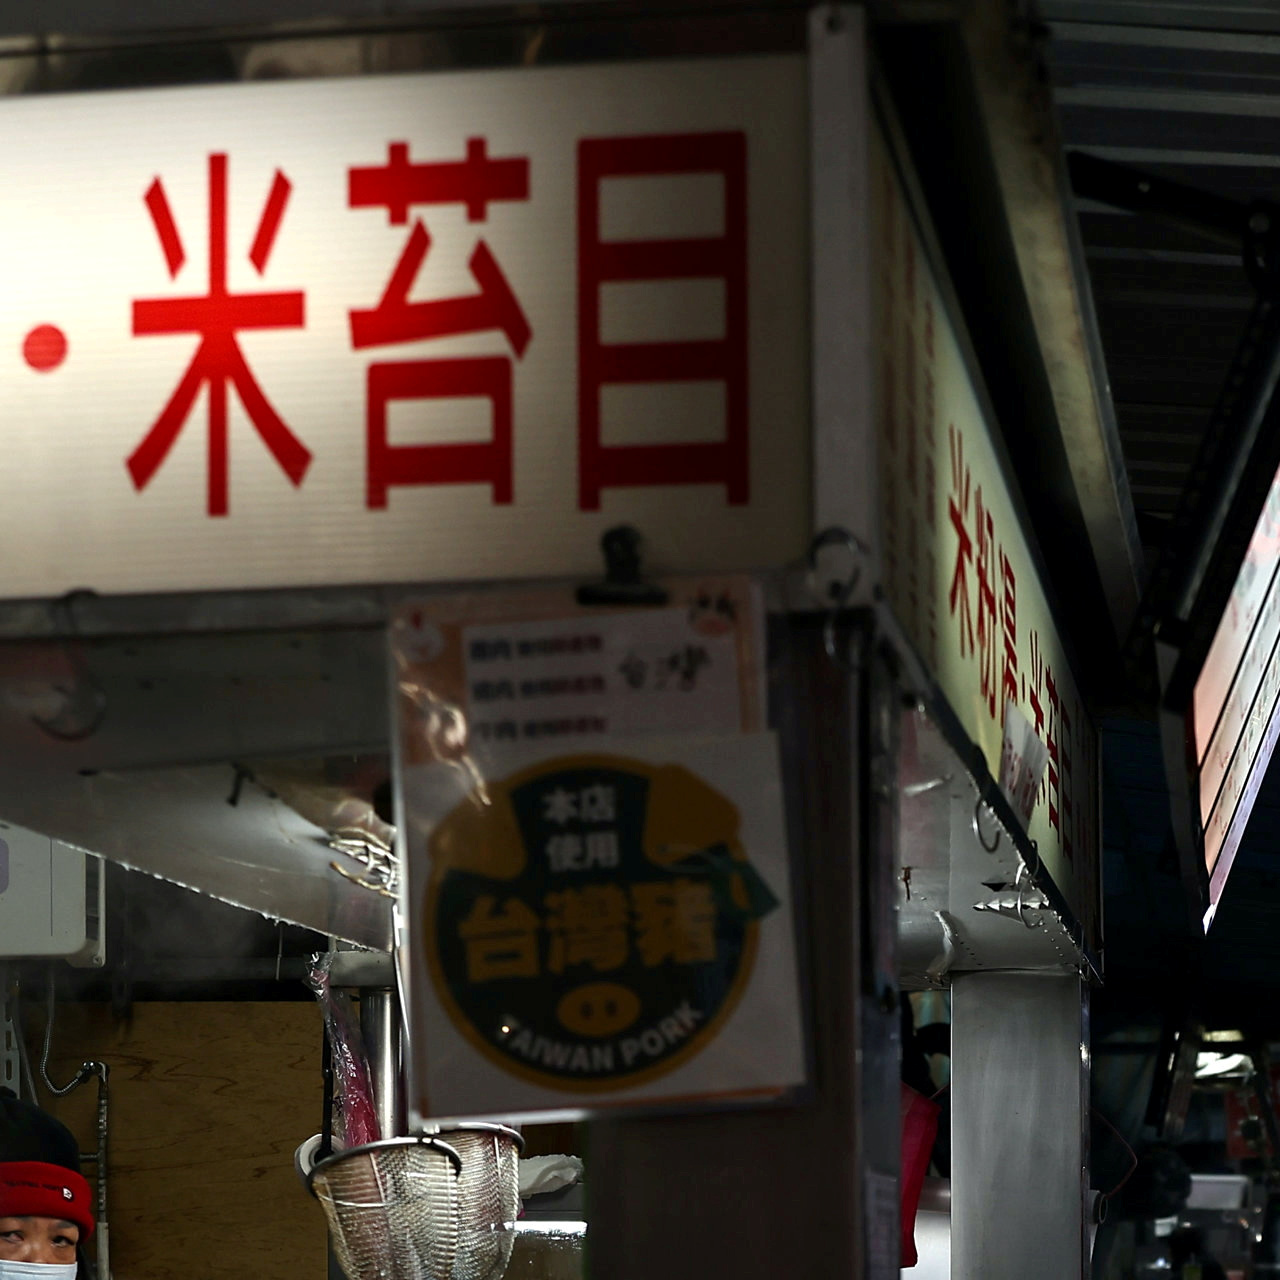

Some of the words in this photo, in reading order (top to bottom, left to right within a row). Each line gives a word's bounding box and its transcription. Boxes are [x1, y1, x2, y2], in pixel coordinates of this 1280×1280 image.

[542, 785, 618, 824] 本店
[546, 829, 620, 873] 使用
[457, 876, 718, 983] 台灣豬
[497, 1013, 616, 1072] TAIWAN
[619, 1000, 705, 1067] PORK
